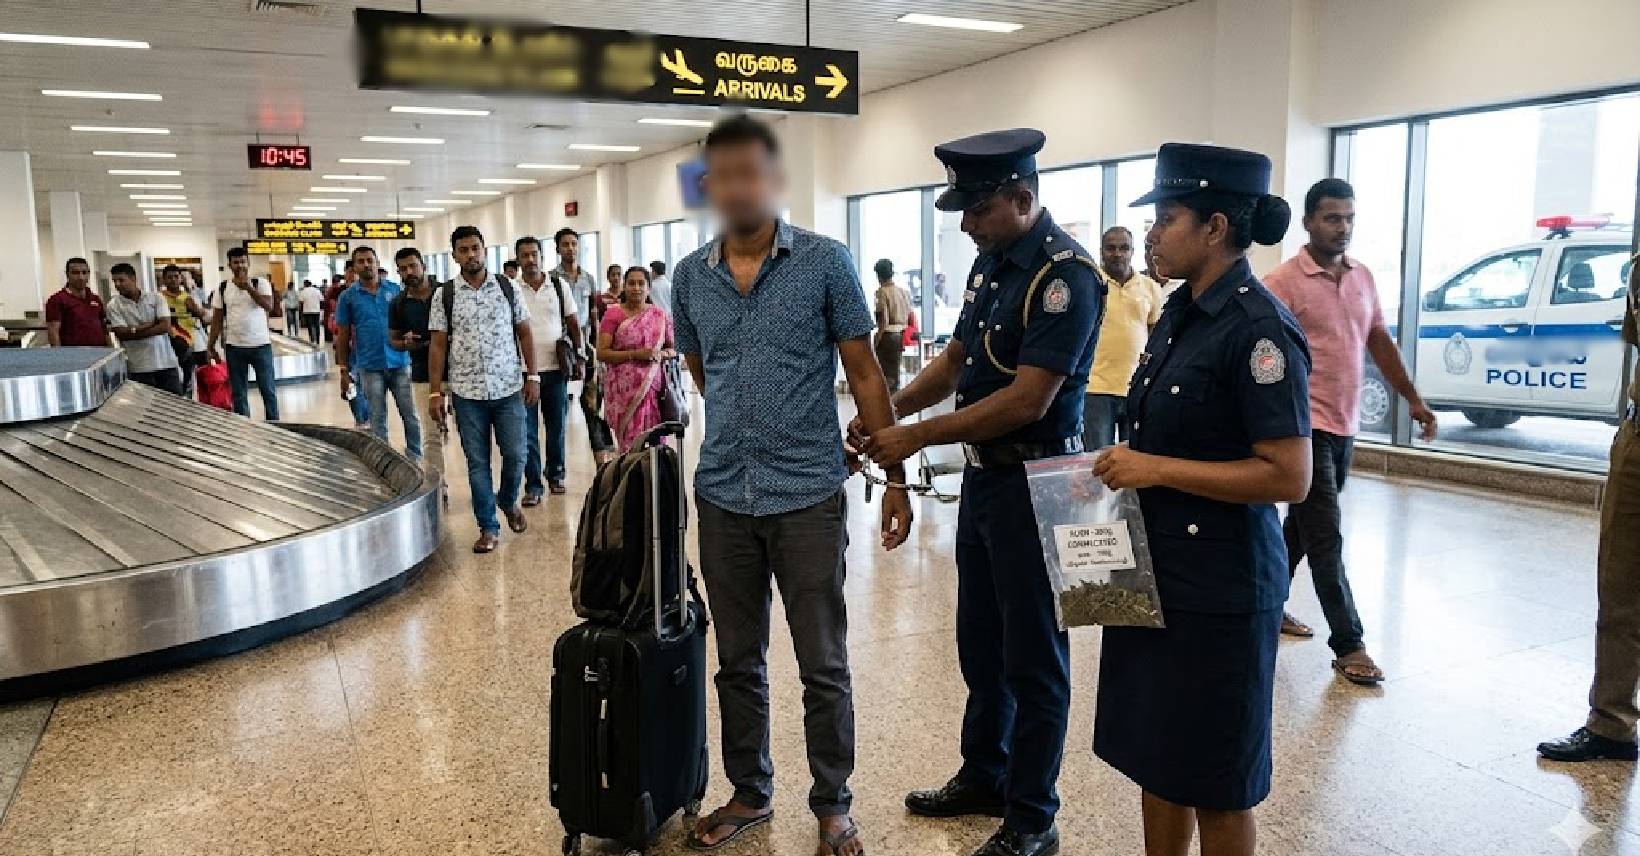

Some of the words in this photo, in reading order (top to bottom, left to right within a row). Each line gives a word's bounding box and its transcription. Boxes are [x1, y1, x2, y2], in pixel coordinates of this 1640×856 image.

[716, 52, 797, 76] வருகை
[714, 79, 806, 103] ARRIVALS
[260, 147, 306, 165] 10:45
[1486, 369, 1587, 390] POLICE
